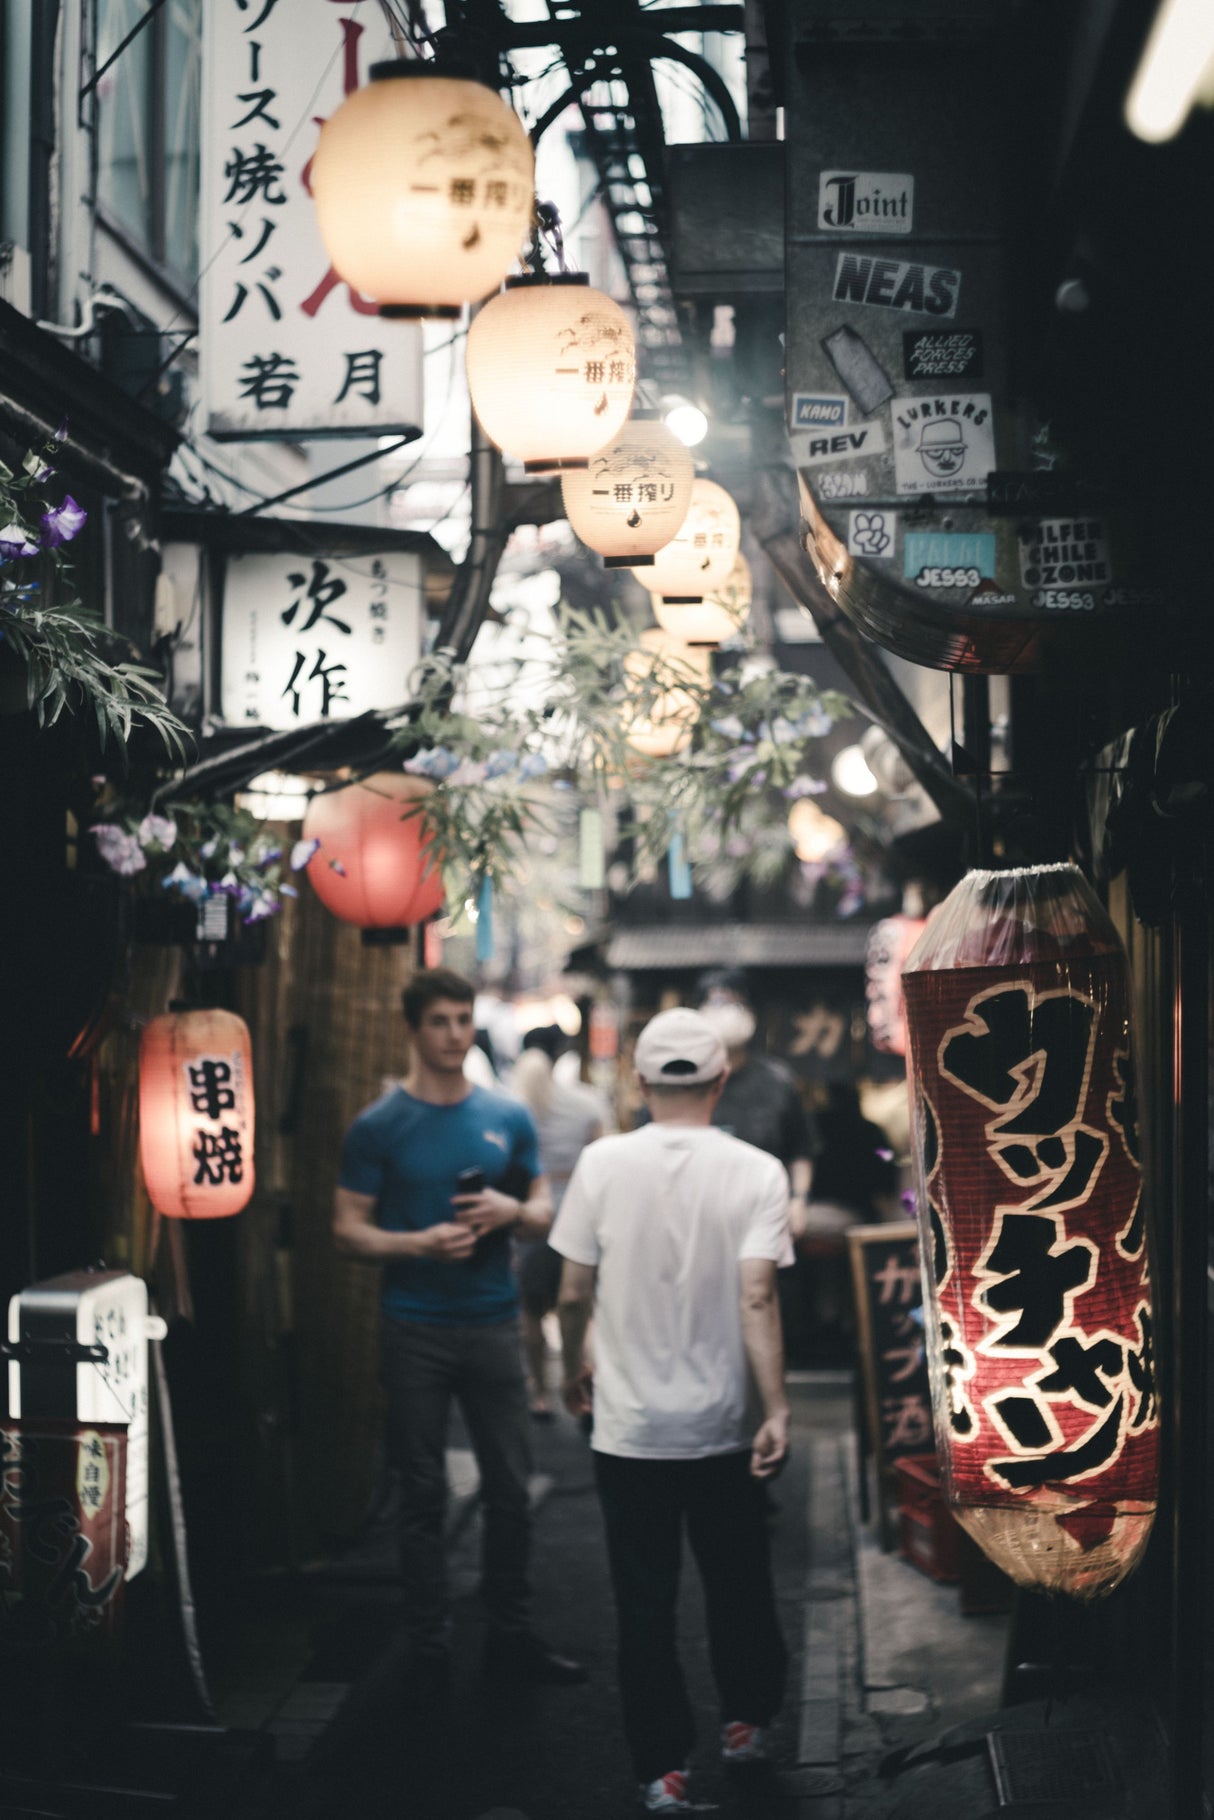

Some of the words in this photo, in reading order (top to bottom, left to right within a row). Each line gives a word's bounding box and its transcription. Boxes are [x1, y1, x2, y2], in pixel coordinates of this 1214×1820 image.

[823, 176, 907, 228] Joint
[834, 256, 957, 315] NEAS
[914, 334, 974, 349] ALLIED
[910, 347, 977, 362] FORCES
[238, 348, 385, 410] 若月
[912, 360, 968, 375] PRESS
[800, 403, 841, 421] KAMO
[897, 399, 988, 430] LURKERS
[809, 430, 868, 458] REV
[592, 483, 675, 503] 一番搾り
[1017, 522, 1103, 545] ILFER
[1029, 542, 1097, 565] CHILE
[916, 568, 982, 588] JESS3
[1024, 561, 1107, 587] OZONE
[1032, 590, 1095, 611] JESS3
[280, 560, 352, 717] 次作
[189, 1060, 242, 1186] 串焼
